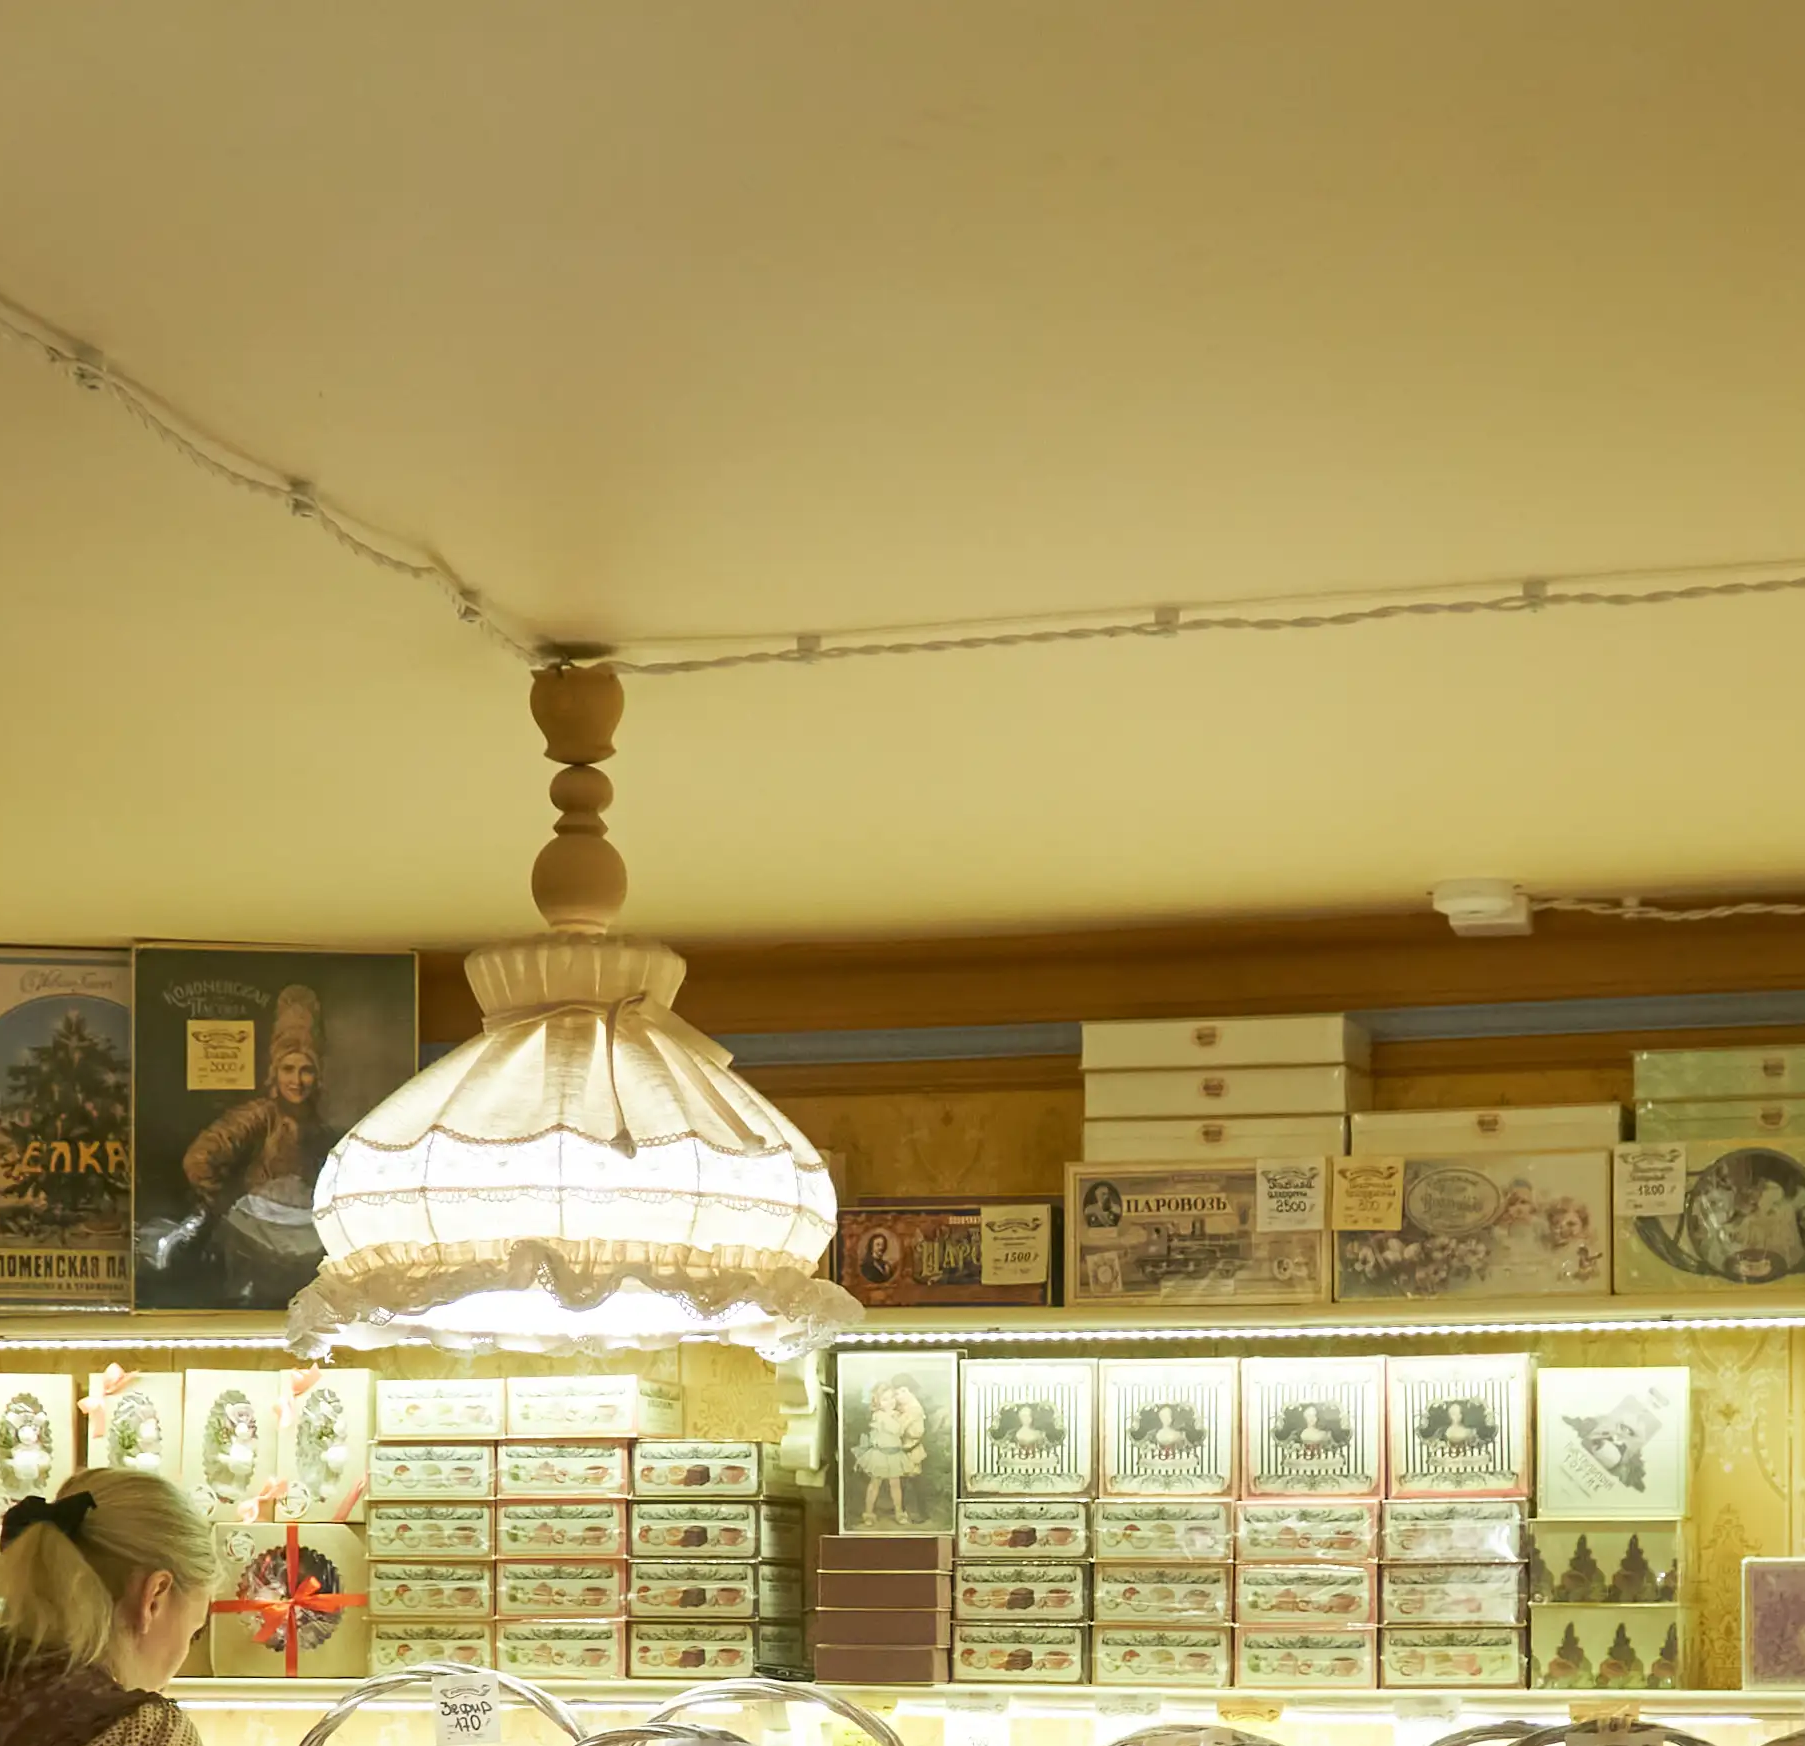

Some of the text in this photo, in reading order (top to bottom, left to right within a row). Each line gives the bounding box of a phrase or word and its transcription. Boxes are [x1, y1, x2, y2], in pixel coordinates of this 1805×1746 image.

[163, 979, 271, 1008] КОЛОМЕНСКАЯ
[1275, 1199, 1307, 1213] 2500
[1003, 1251, 1032, 1264] 1500
[439, 1700, 493, 1717] Зефир
[454, 1714, 482, 1732] 170
